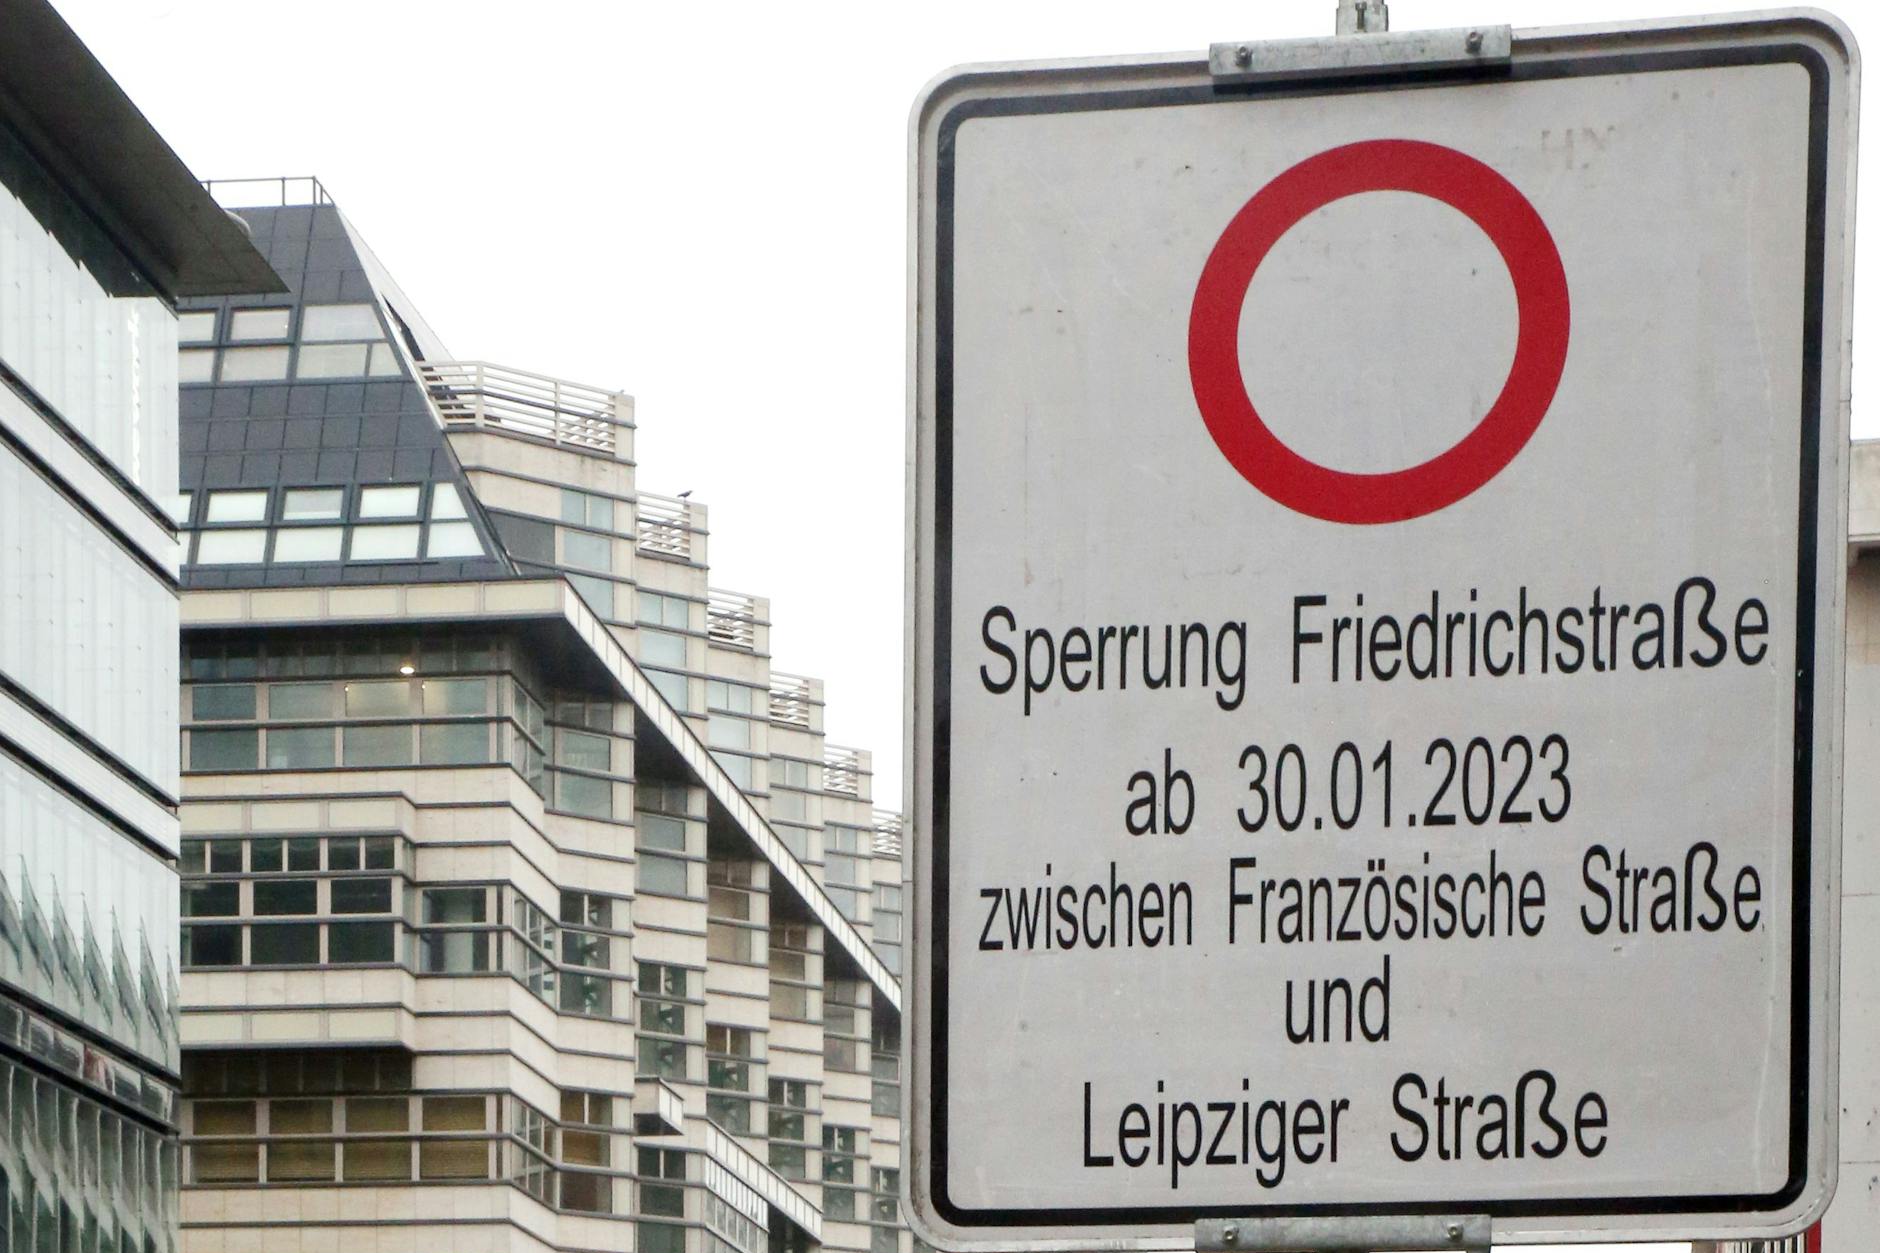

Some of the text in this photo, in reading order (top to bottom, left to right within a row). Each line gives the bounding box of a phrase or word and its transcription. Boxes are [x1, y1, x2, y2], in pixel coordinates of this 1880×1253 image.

[980, 576, 1769, 717] Sperrung Friedrichstraße
[1125, 733, 1572, 836] ab 30.01.2023
[978, 841, 1762, 951] zwischen Französische Straße
[1285, 954, 1390, 1045] und
[1083, 1069, 1608, 1190] Leipziger Straße
